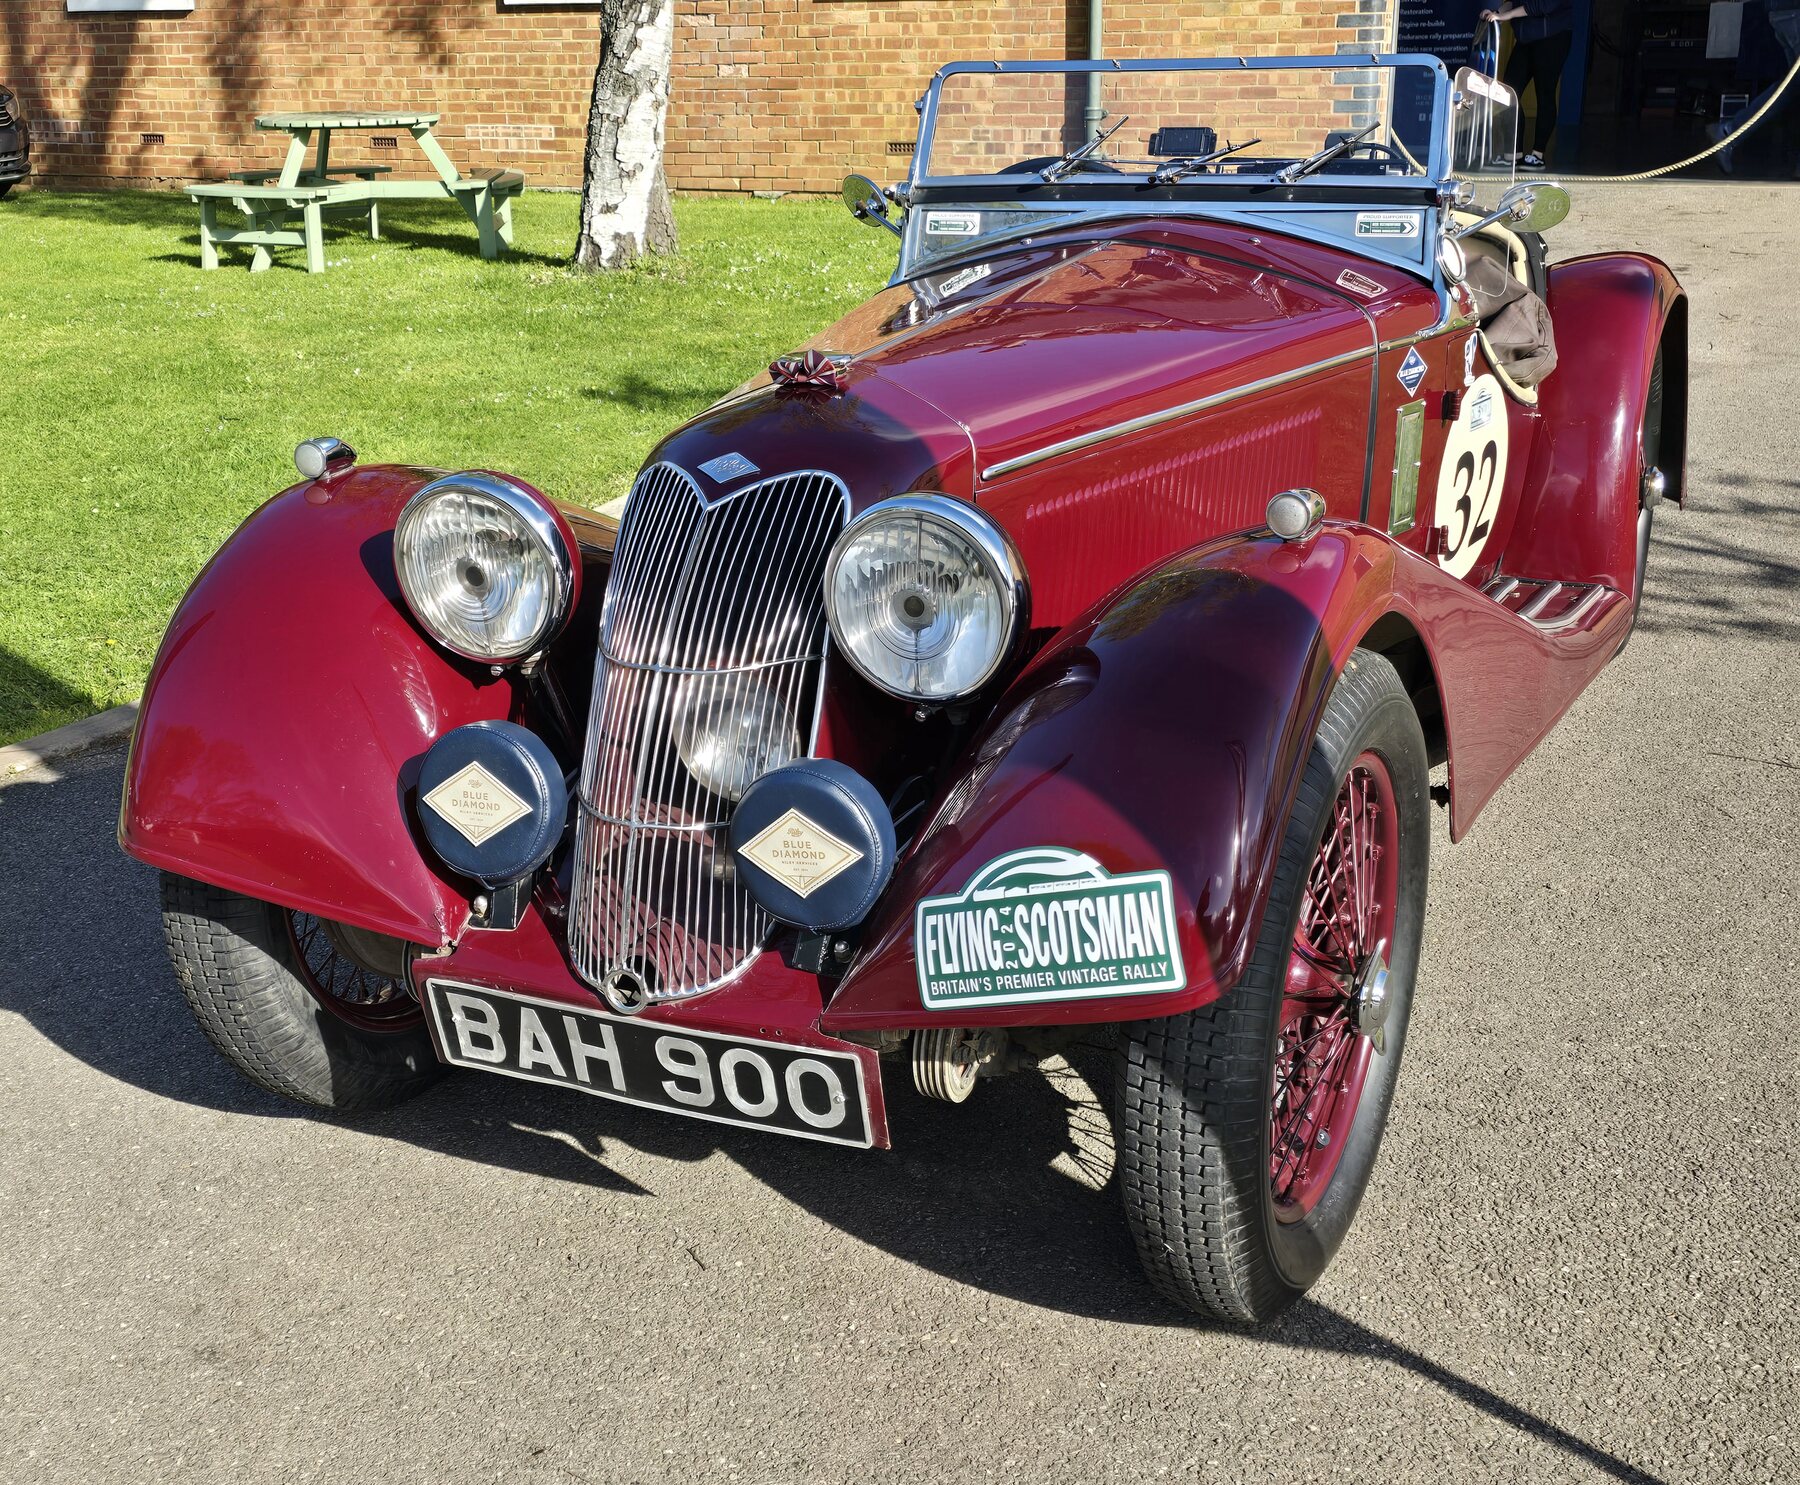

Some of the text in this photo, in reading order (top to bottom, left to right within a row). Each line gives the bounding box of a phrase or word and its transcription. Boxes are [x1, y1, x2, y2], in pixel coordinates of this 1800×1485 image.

[1399, 21, 1419, 29] Engine
[1429, 32, 1441, 41] rally
[1443, 440, 1497, 561] 32
[462, 790, 489, 801] BLUE
[452, 799, 501, 811] DIAMOND
[783, 840, 812, 850] BLUE
[772, 849, 826, 860] DIAMOND
[925, 890, 1166, 976] FLYING SCOTSMAN
[999, 906, 1019, 969] 2024
[930, 961, 1168, 996] BRITAIN'S PREMIER VINTAGE RALLY
[445, 991, 846, 1129] BAH 900
